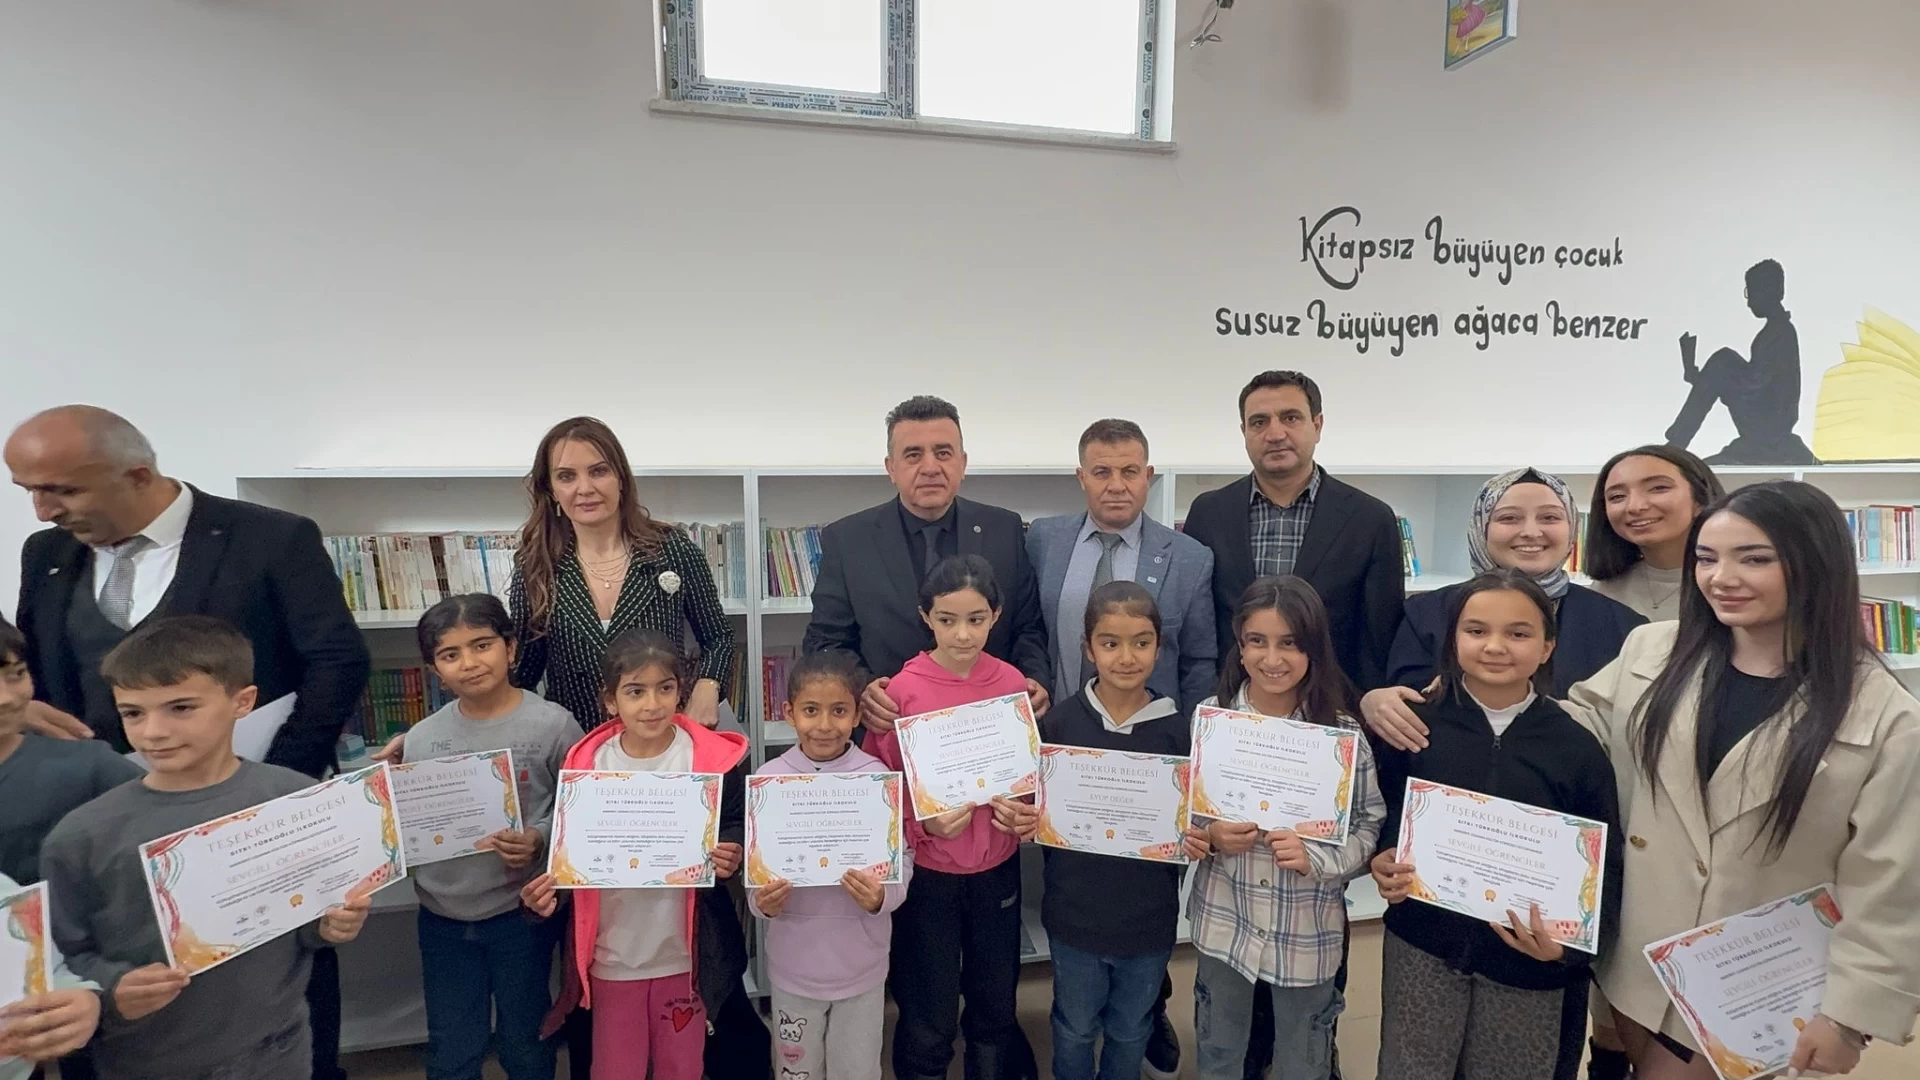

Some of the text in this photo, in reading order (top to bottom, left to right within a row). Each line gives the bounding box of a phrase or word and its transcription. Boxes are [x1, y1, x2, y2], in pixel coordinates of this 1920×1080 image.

[1299, 206, 1624, 290] Kitapsız büyüyen çocuk
[1215, 300, 1649, 357] susuz büyüyen ağaca benzer
[430, 739, 452, 752] THE
[290, 795, 346, 823] BELGESİ
[1508, 821, 1558, 838] BELGESİ
